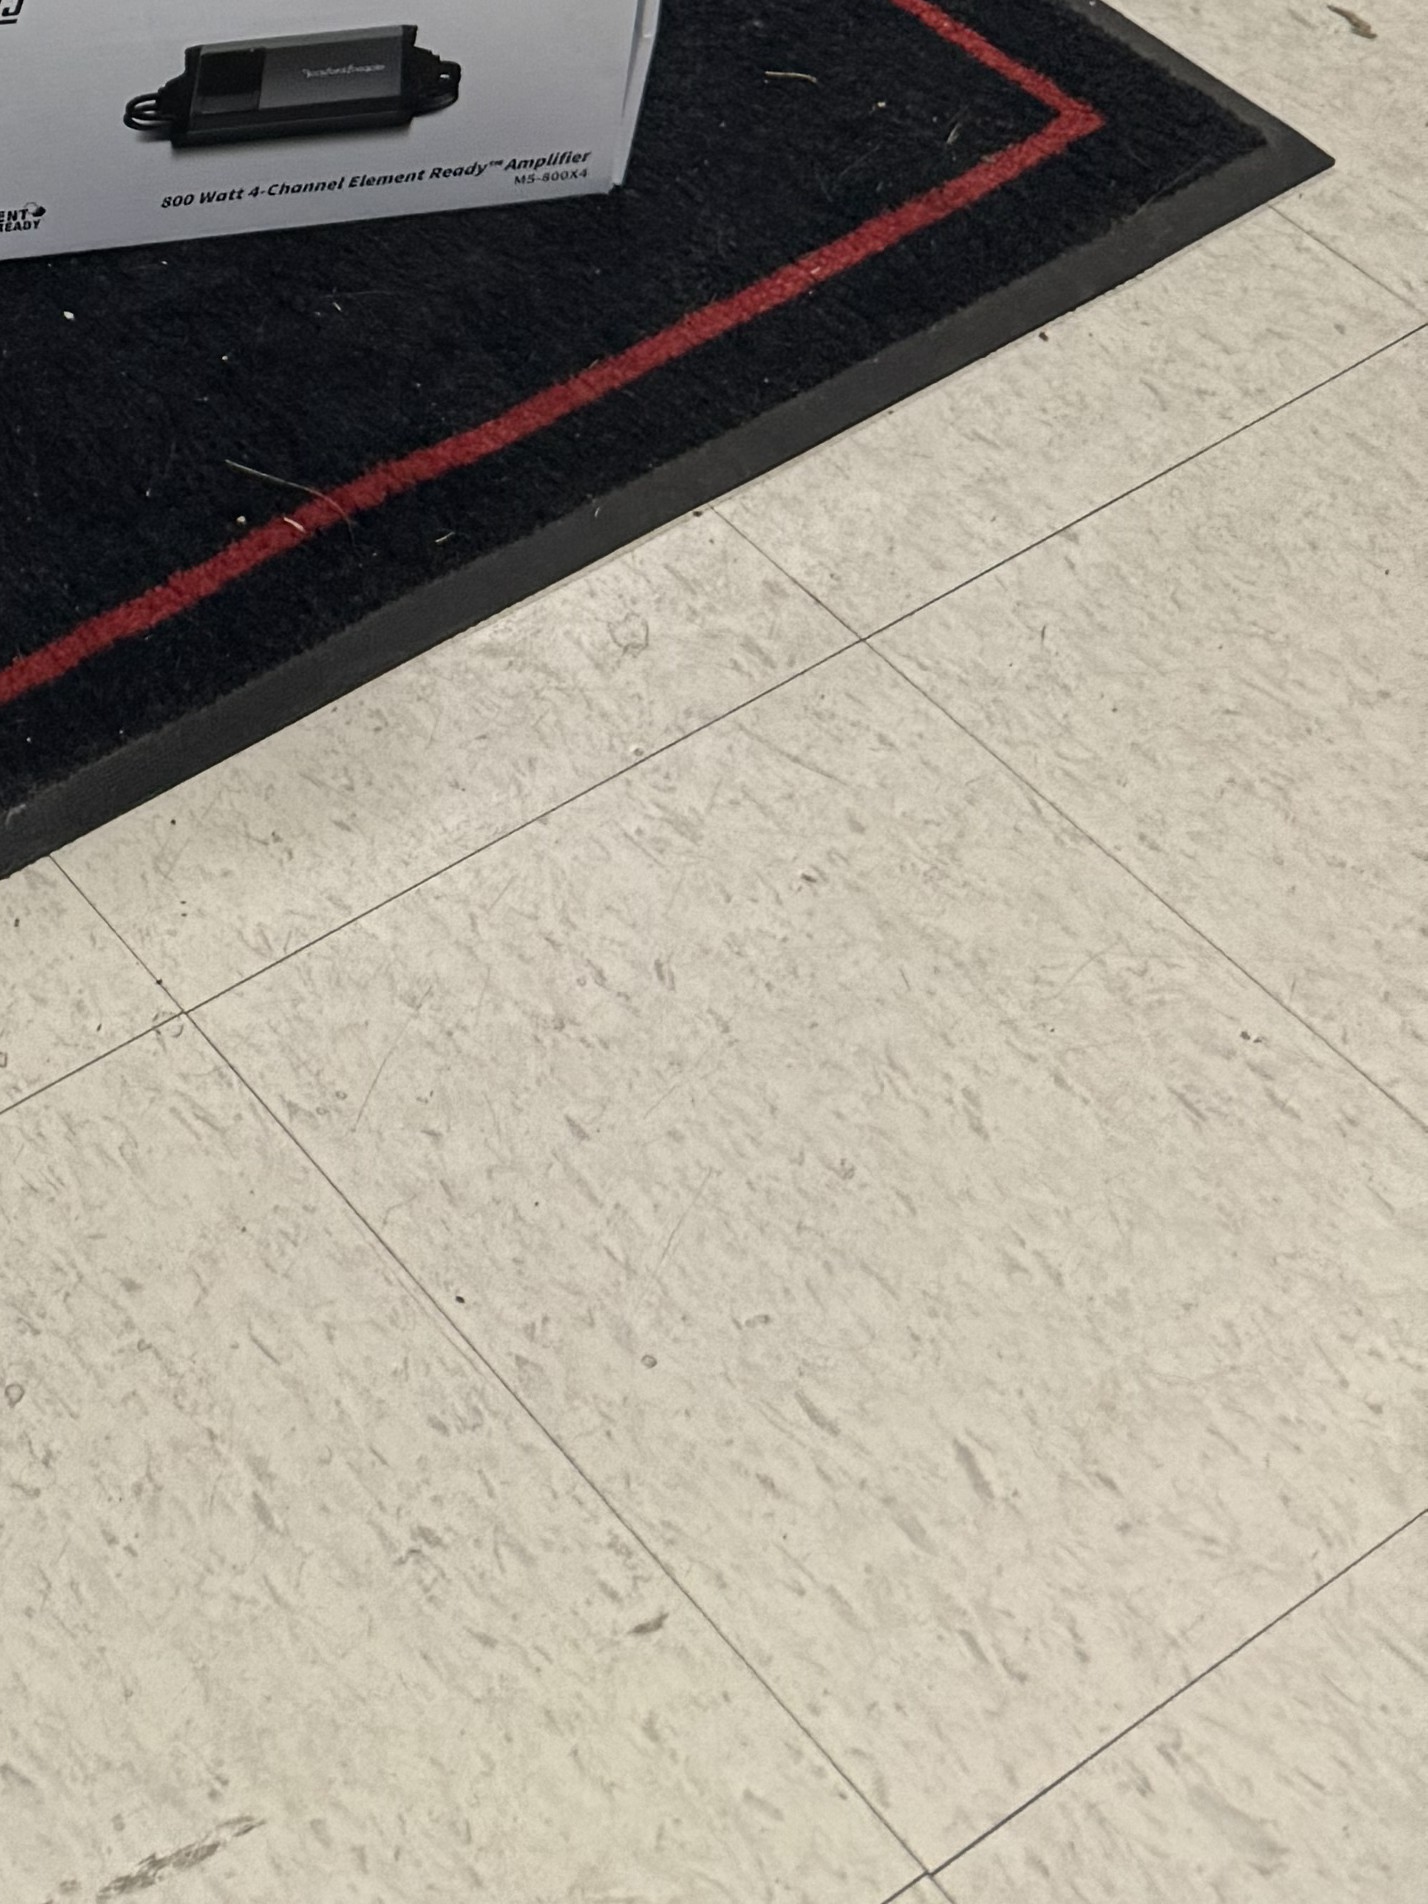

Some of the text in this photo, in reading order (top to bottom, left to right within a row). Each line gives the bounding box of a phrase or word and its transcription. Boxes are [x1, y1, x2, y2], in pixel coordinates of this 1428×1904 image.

[161, 193, 195, 209] 800
[199, 188, 245, 204] Watt
[247, 176, 345, 198] 4-Channel
[348, 169, 426, 190] Element
[504, 149, 592, 172] Amplifier
